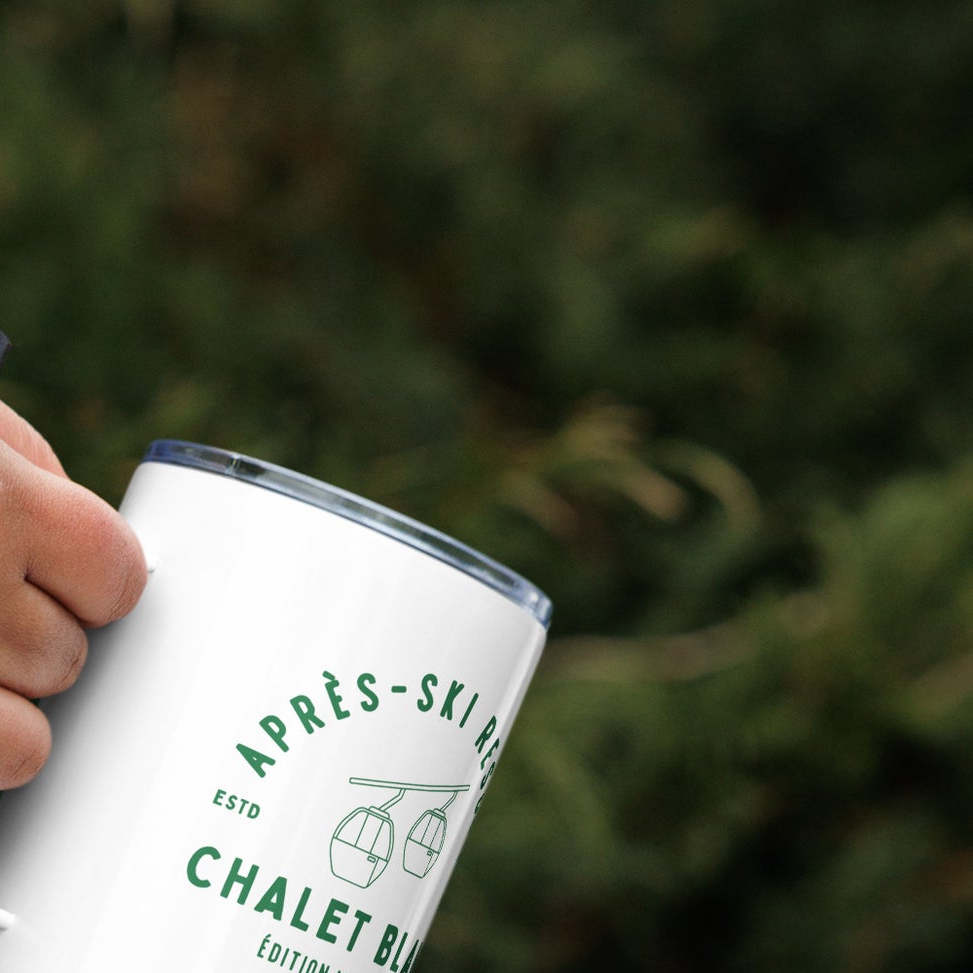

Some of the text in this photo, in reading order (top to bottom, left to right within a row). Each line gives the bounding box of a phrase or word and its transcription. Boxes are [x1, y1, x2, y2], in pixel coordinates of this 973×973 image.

[236, 671, 499, 813] APRÈS-SKI RES
[212, 789, 260, 819] ESTD
[186, 846, 372, 951] CHALET
